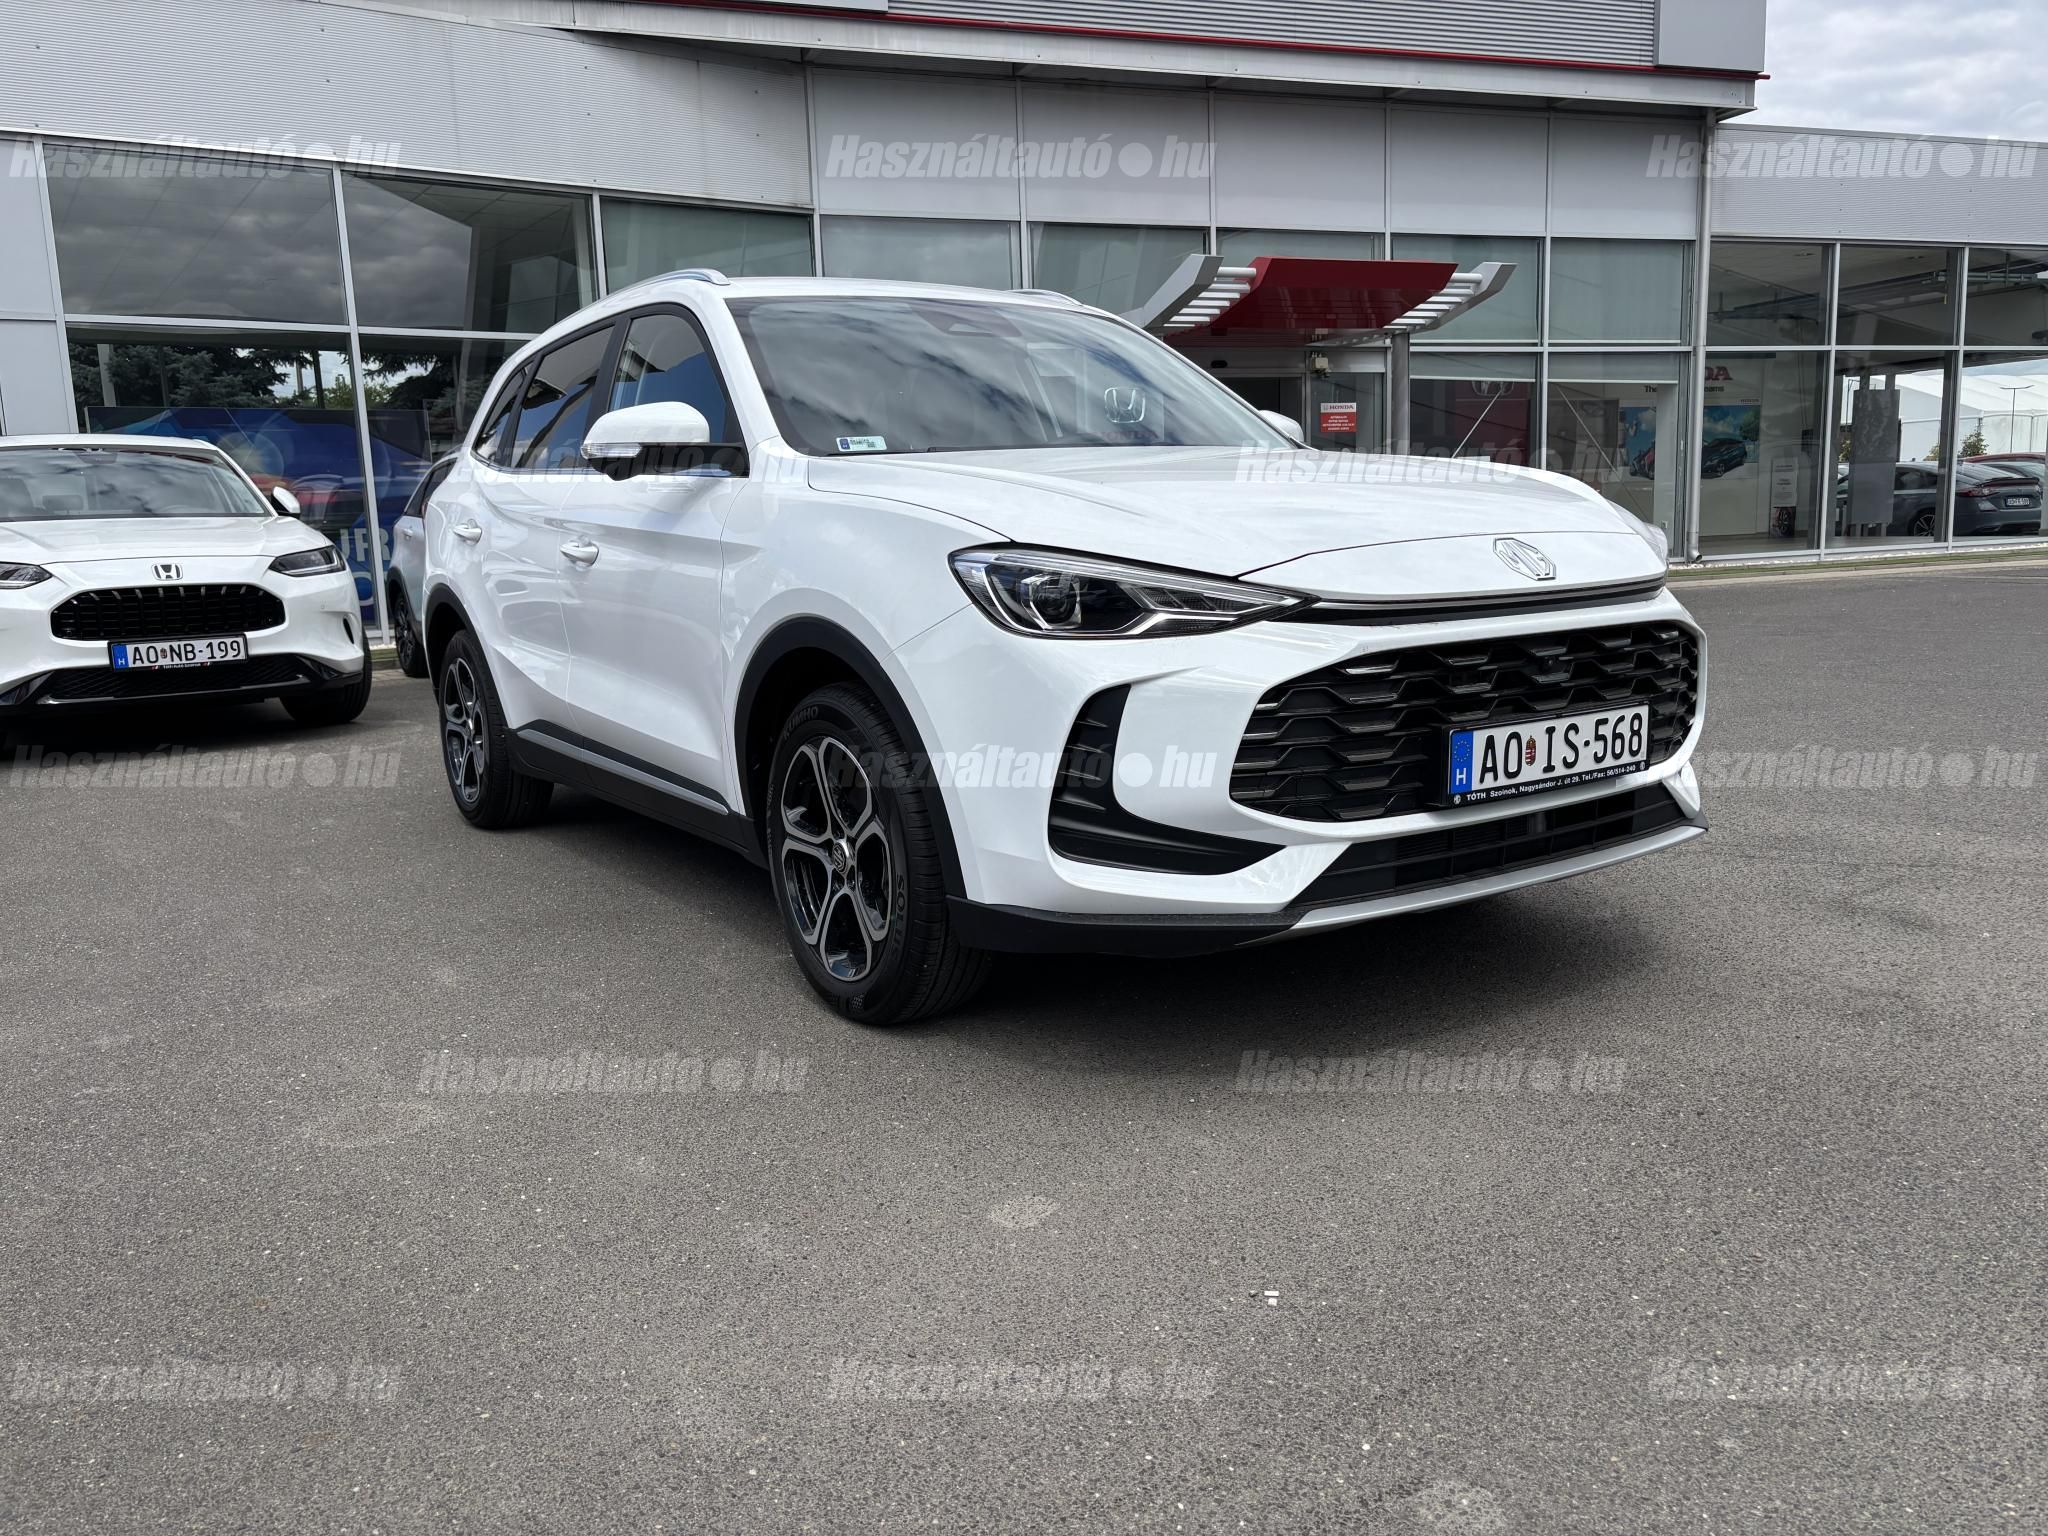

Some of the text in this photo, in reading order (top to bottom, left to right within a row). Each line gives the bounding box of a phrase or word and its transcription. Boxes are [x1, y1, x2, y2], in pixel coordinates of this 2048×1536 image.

[132, 640, 241, 665] AO NB-199
[1479, 712, 1643, 784] AO IS-568
[1455, 767, 1467, 786] H
[1466, 792, 1486, 801] TÓTH
